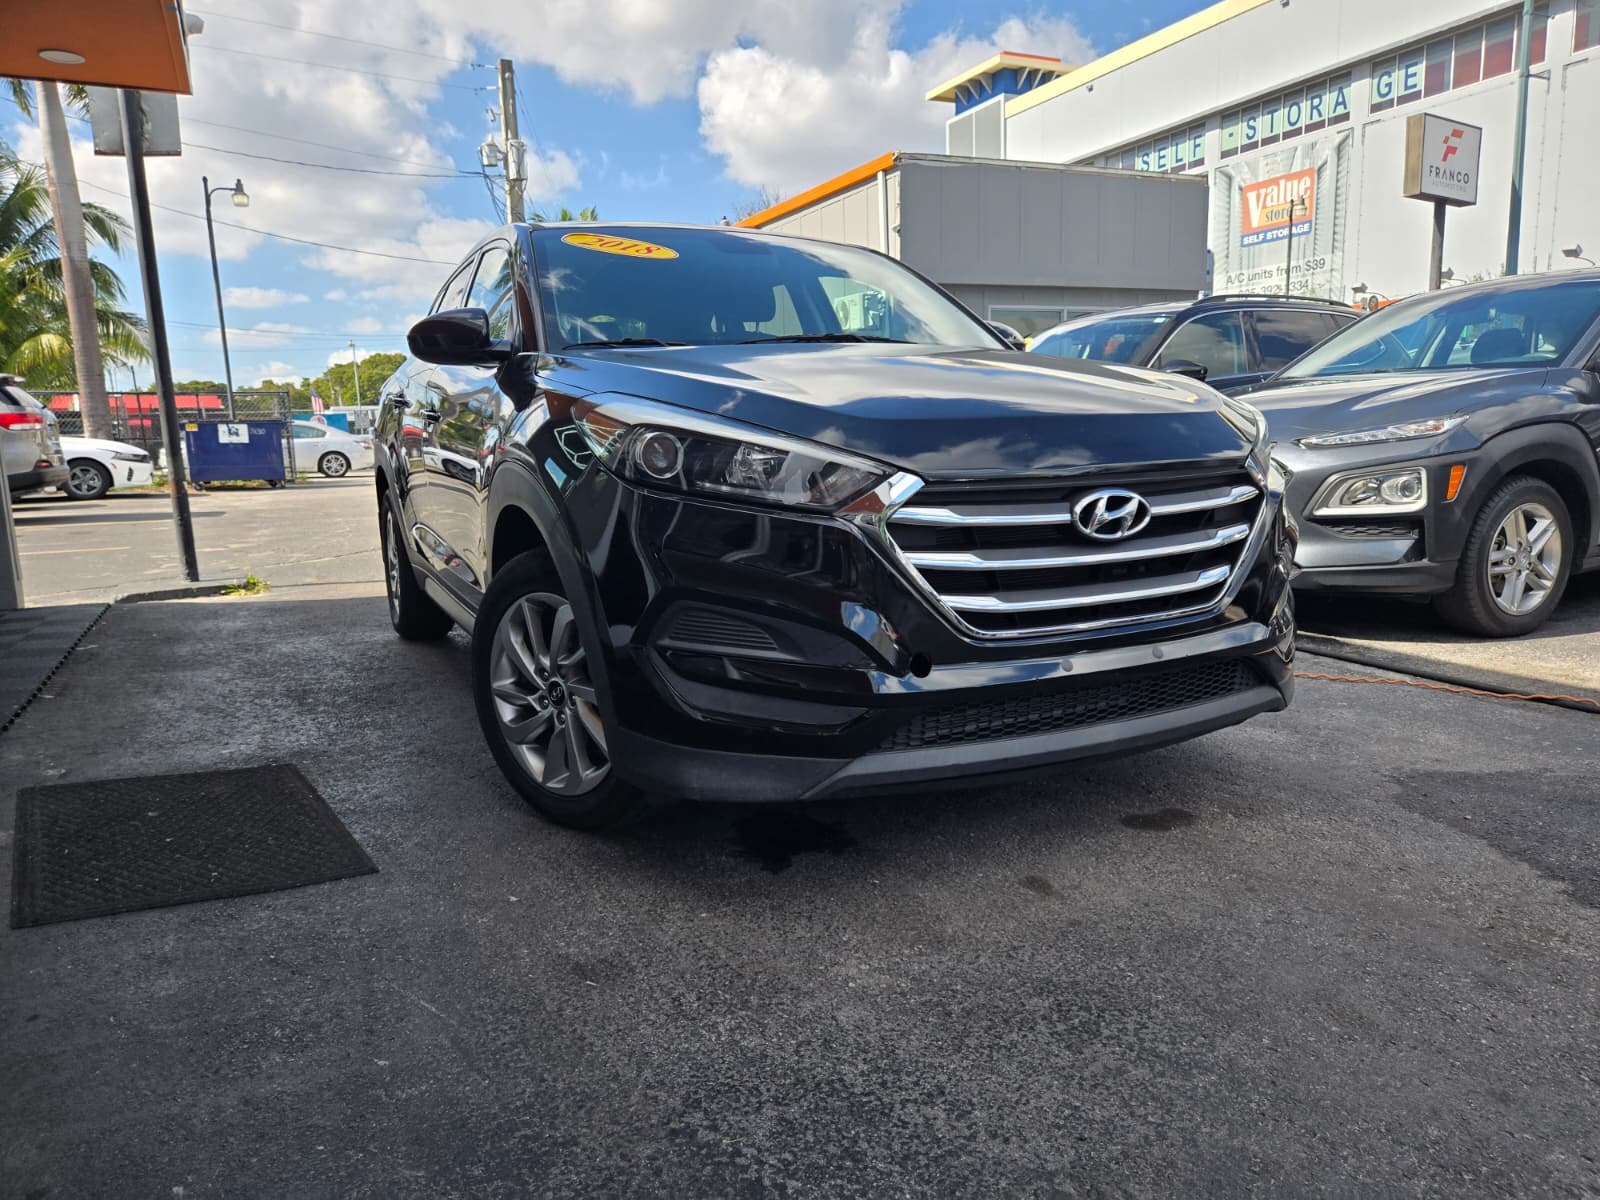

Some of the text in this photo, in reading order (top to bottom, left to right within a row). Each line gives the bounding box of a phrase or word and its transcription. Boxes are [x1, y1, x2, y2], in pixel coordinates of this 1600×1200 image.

[1140, 134, 1203, 171] SELF
[1429, 165, 1470, 184] FRANCO
[1246, 176, 1311, 229] Value
[1243, 223, 1310, 245] SELF STORAGE
[577, 237, 661, 255] 2018
[1247, 269, 1273, 281] units
[1305, 257, 1326, 272] $39
